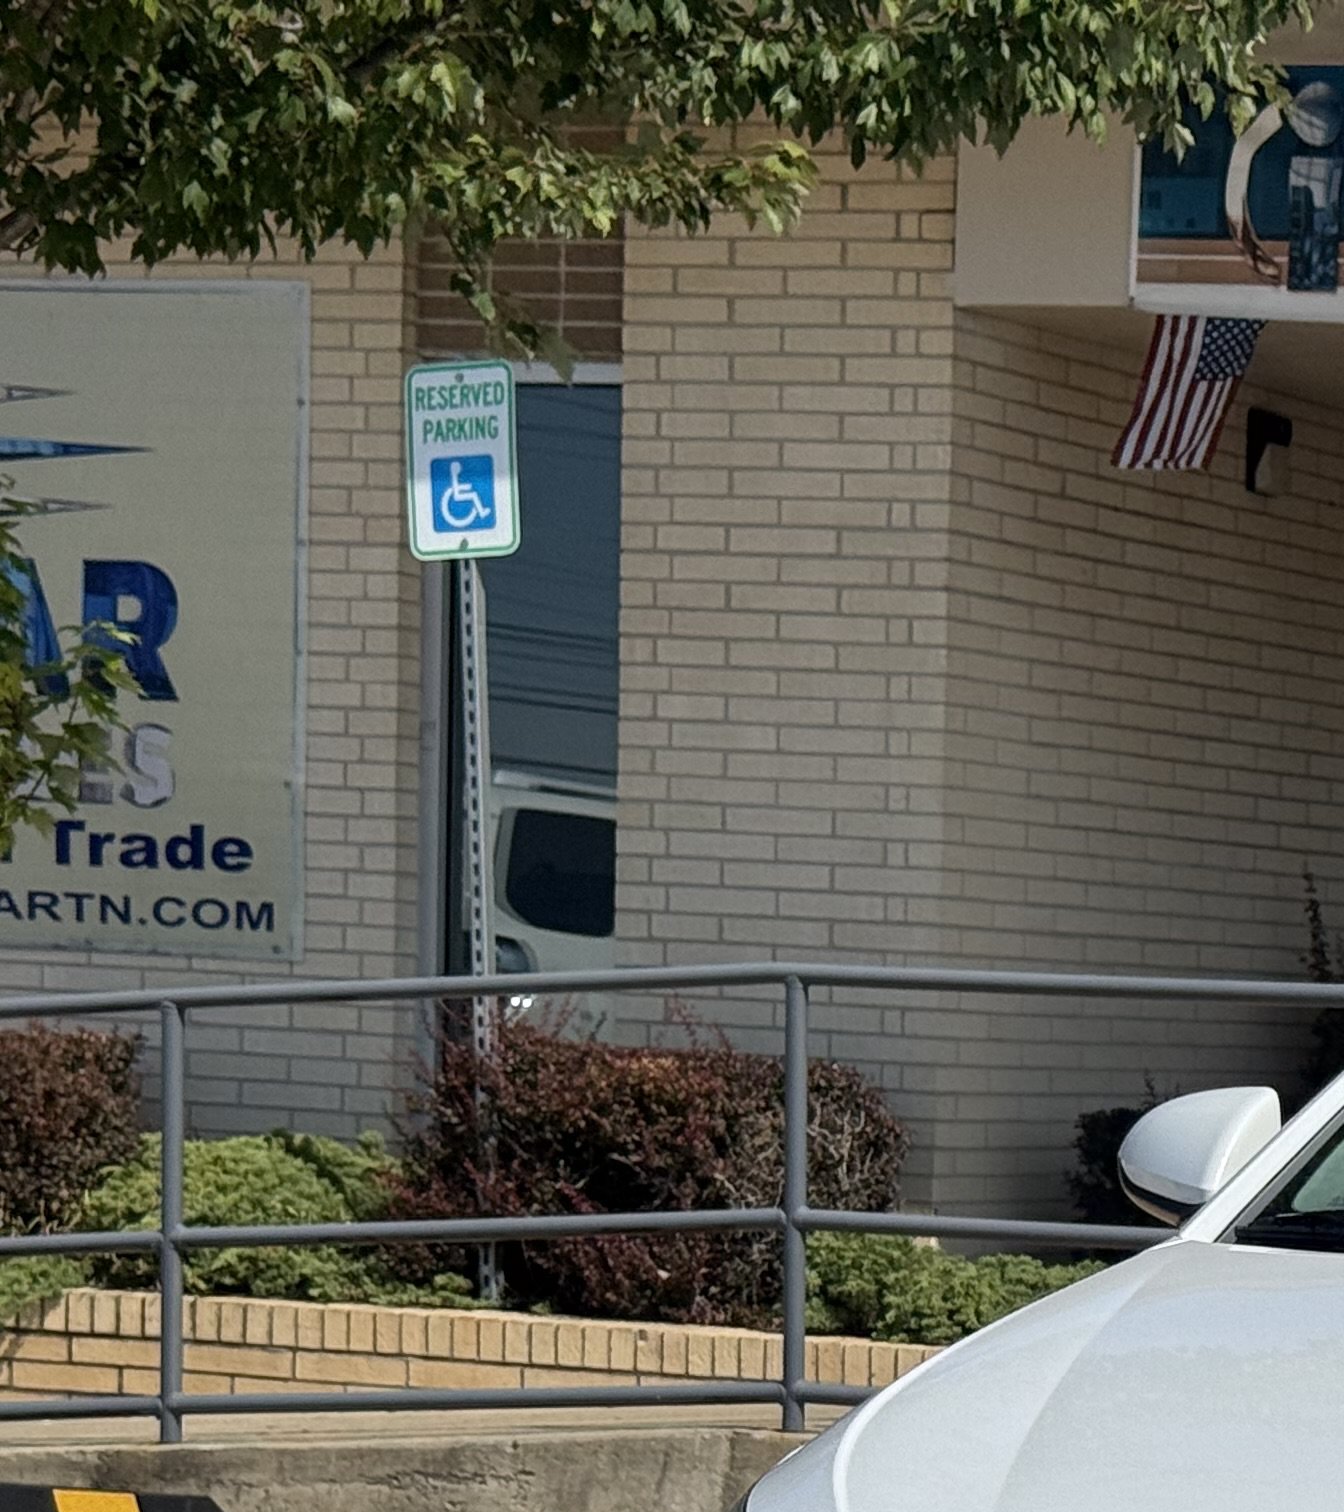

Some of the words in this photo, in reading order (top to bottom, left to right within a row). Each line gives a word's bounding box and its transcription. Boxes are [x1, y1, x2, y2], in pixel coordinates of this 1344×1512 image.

[415, 381, 505, 412] RESERVED
[422, 416, 499, 444] PARKING
[54, 819, 254, 873] Trade
